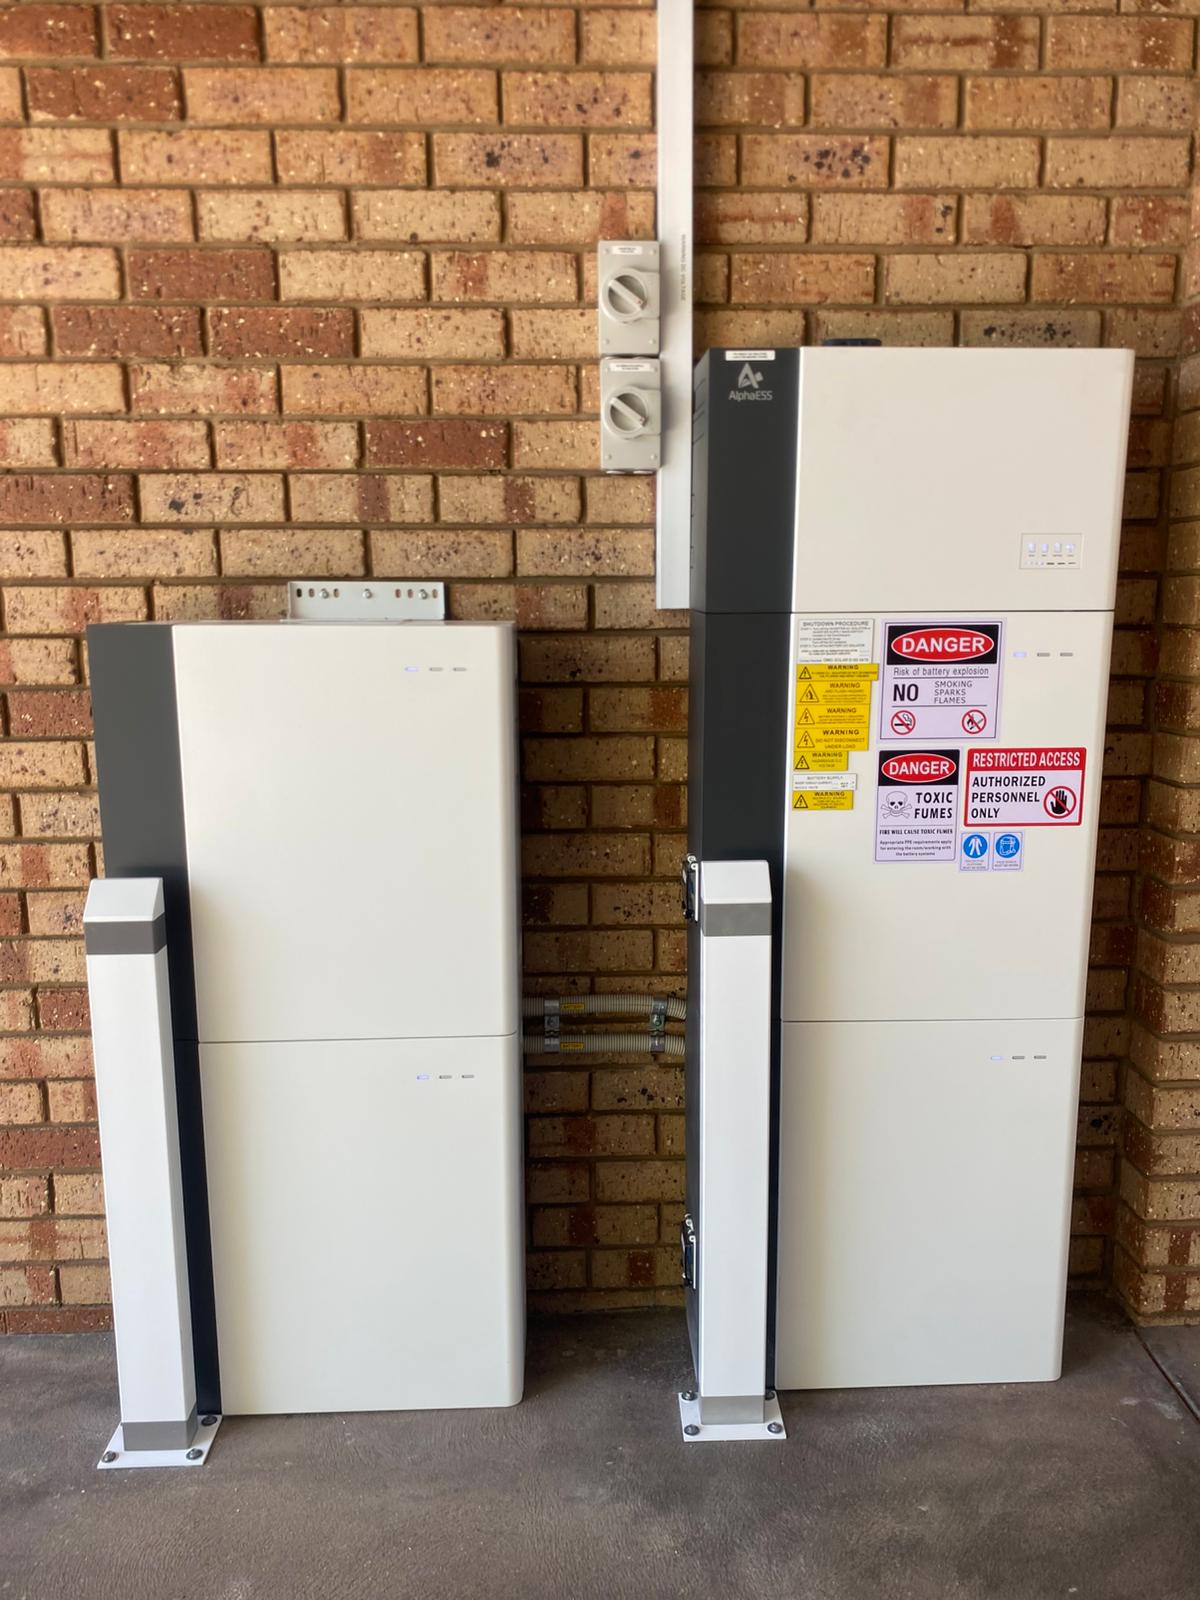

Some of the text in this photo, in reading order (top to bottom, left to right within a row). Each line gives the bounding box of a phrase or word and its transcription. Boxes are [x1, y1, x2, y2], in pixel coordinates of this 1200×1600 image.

[729, 390, 773, 402] AlphaESS
[902, 637, 985, 653] DANGER
[893, 667, 989, 678] Risk of battery explosion
[893, 680, 973, 702] NO SMOKING
[934, 688, 966, 696] SPARKS
[972, 752, 1081, 767] RESTRICTED ACCESS
[889, 761, 949, 775] DANGER
[972, 776, 1046, 787] AUTHORIZED
[916, 792, 953, 804] TOXIC
[971, 791, 1040, 803] PERSONNEL
[914, 808, 953, 819] FUMES
[971, 808, 1000, 818] ONLY
